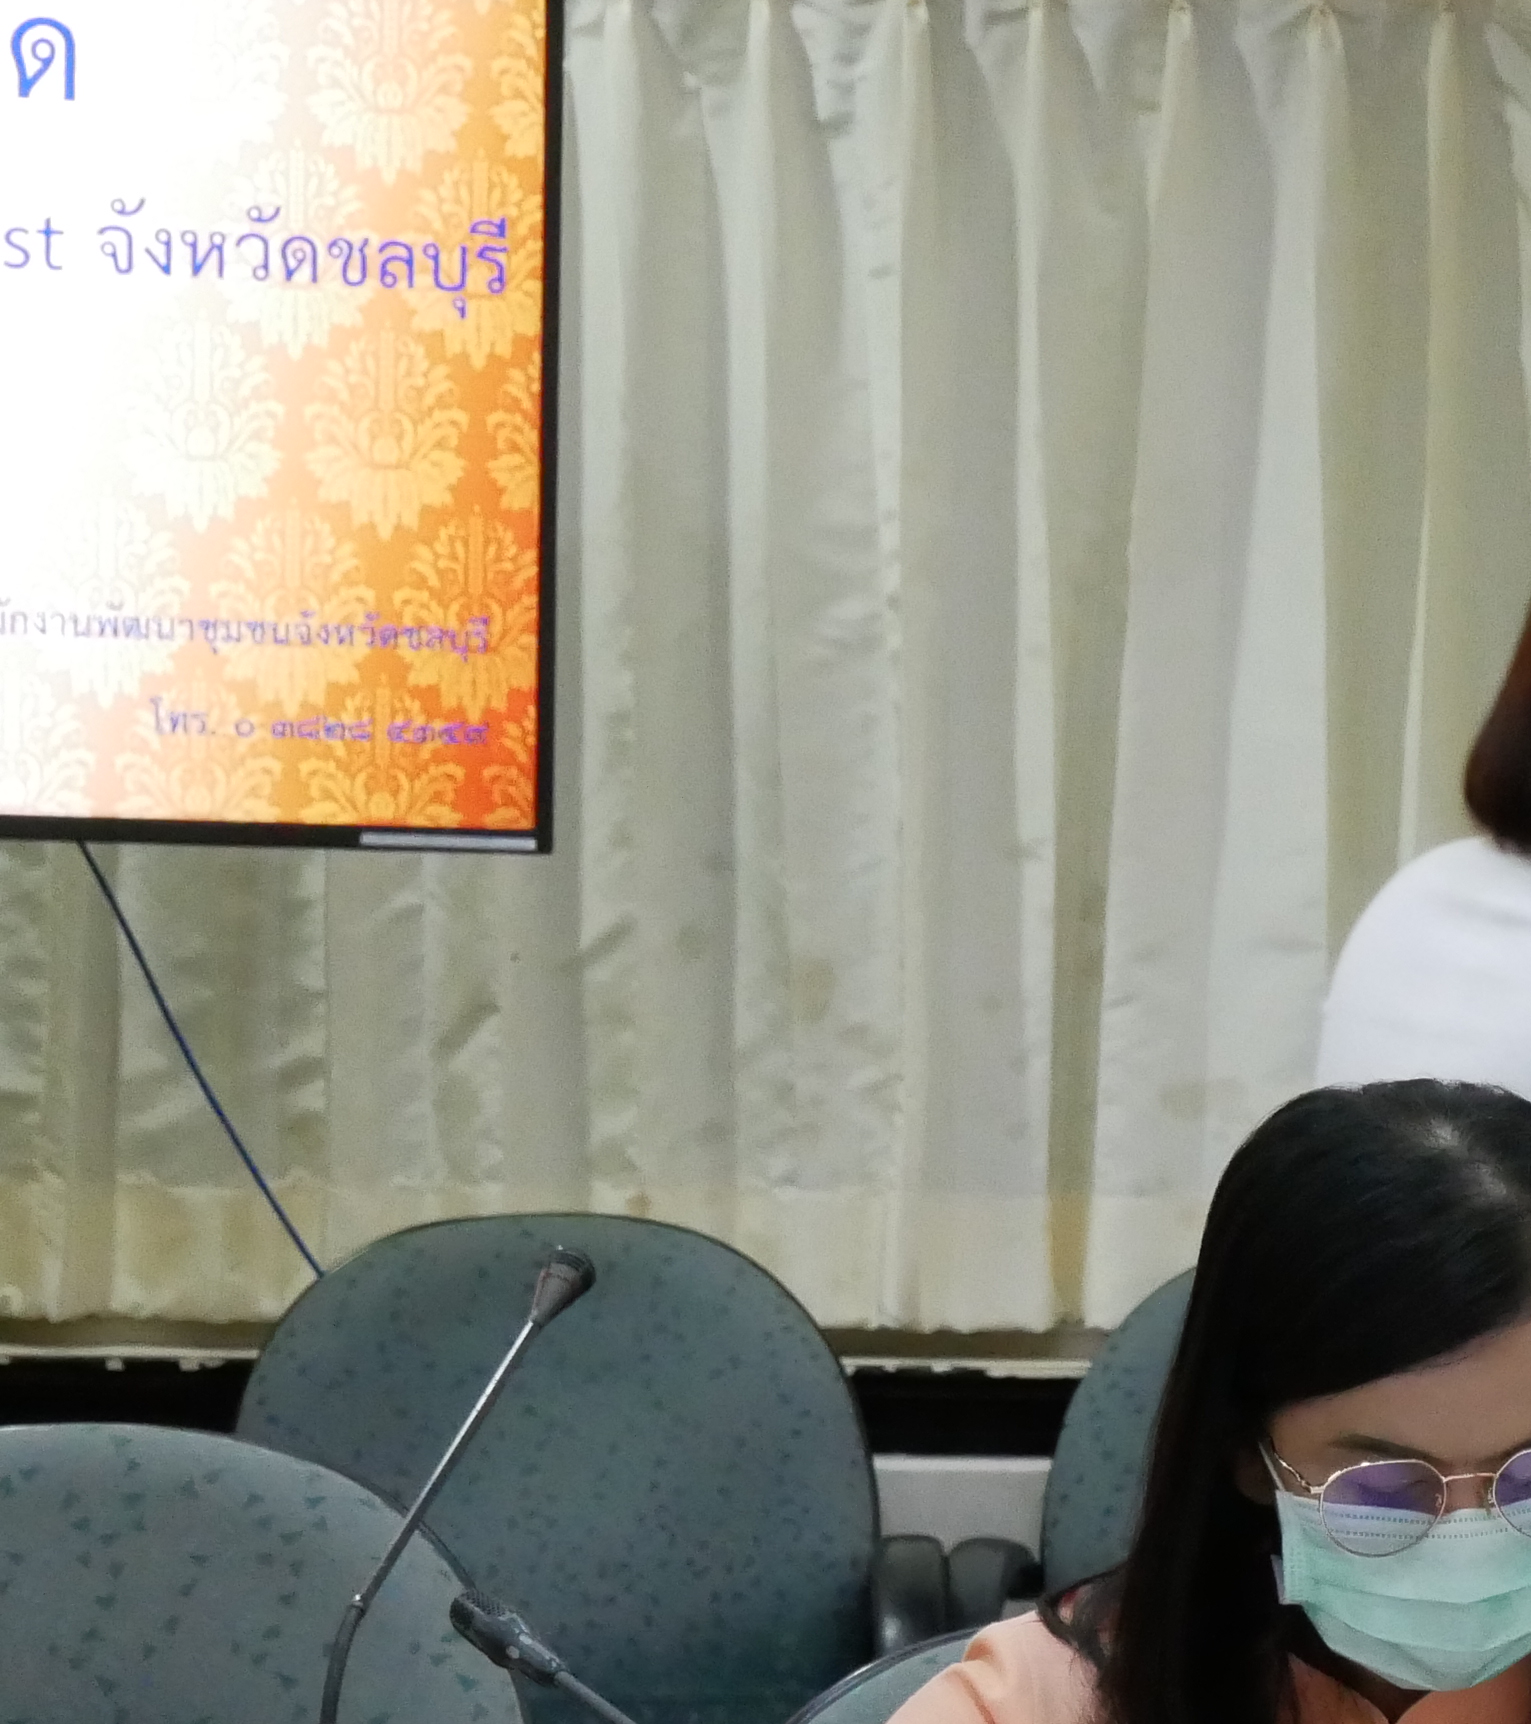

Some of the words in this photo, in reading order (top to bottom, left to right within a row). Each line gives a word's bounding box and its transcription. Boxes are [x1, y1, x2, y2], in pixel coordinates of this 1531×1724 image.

[97, 197, 509, 320] จังหวัดชลบุรี
